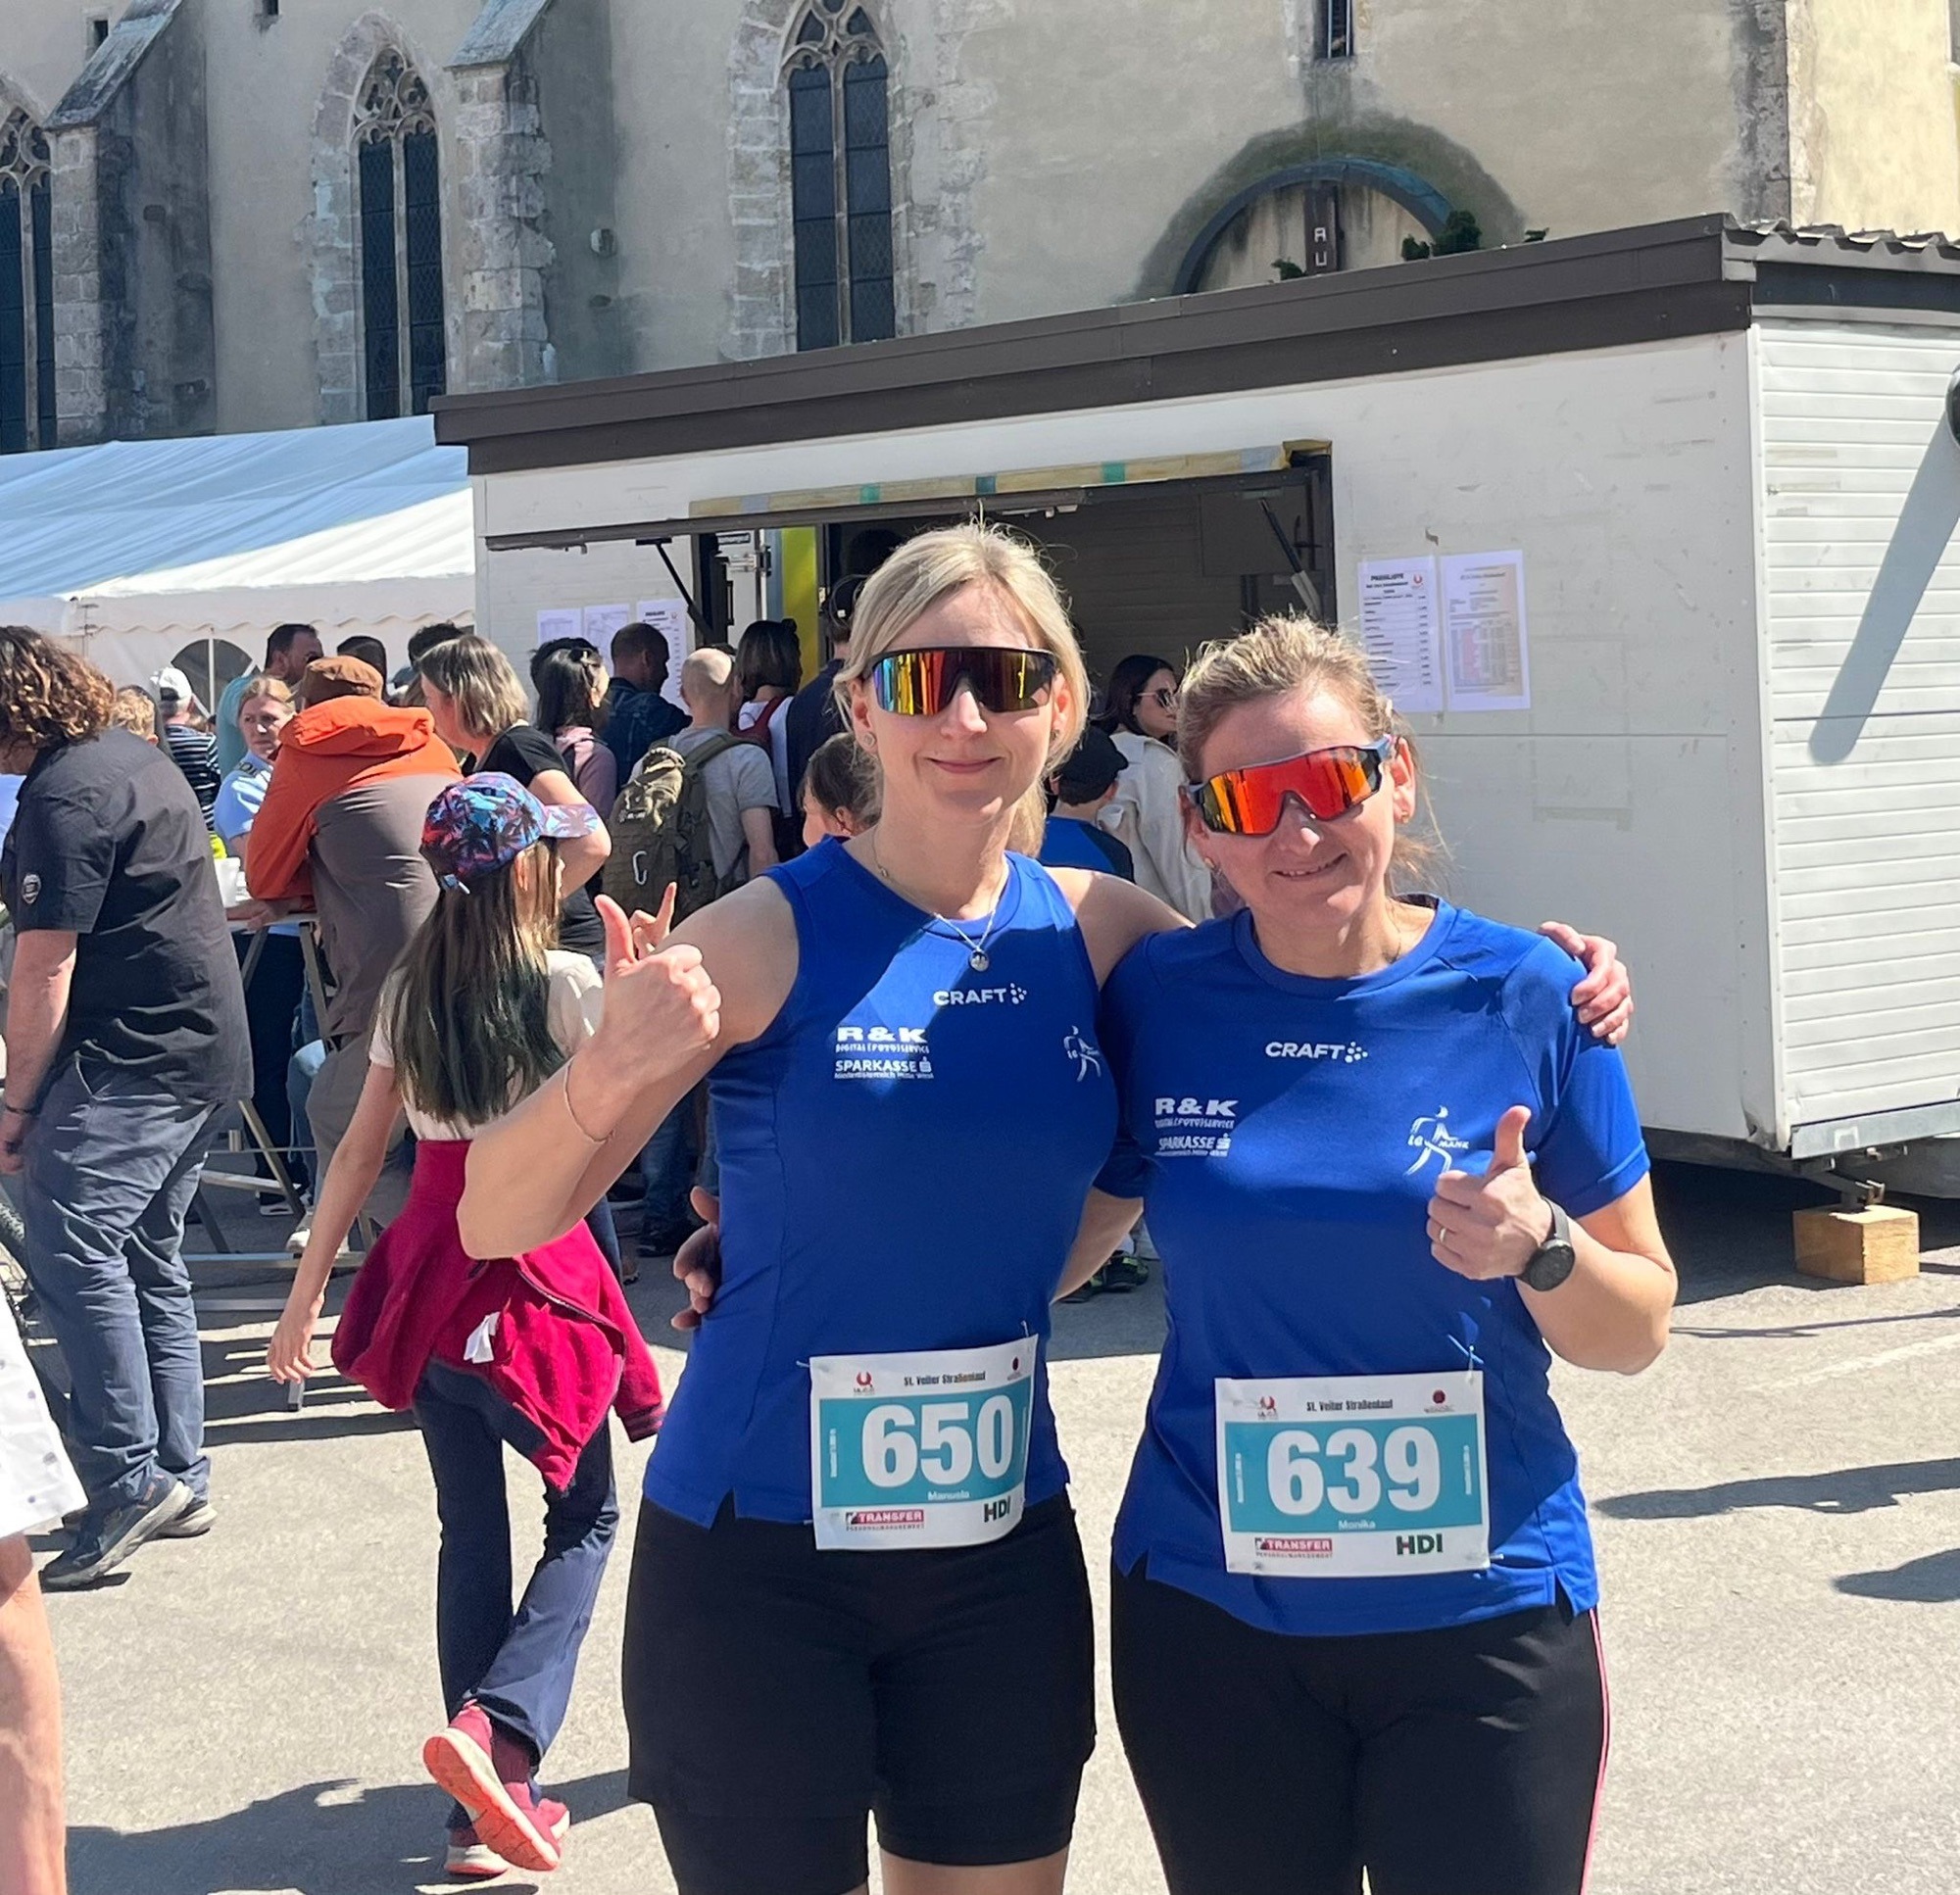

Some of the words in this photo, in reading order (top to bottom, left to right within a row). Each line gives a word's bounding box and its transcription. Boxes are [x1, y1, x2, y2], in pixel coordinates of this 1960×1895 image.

[933, 988, 1006, 1006] CRAFT
[1265, 1042, 1346, 1060] CRAFT
[835, 1059, 917, 1073] SPARKASSE
[862, 1394, 1014, 1487] 650
[1267, 1426, 1441, 1515] 639
[858, 1511, 922, 1523] TRANSFER
[983, 1496, 1011, 1523] HDI
[1338, 1519, 1376, 1531] Monika
[1266, 1539, 1331, 1551] TRANSFER
[1396, 1533, 1444, 1556] HDI
